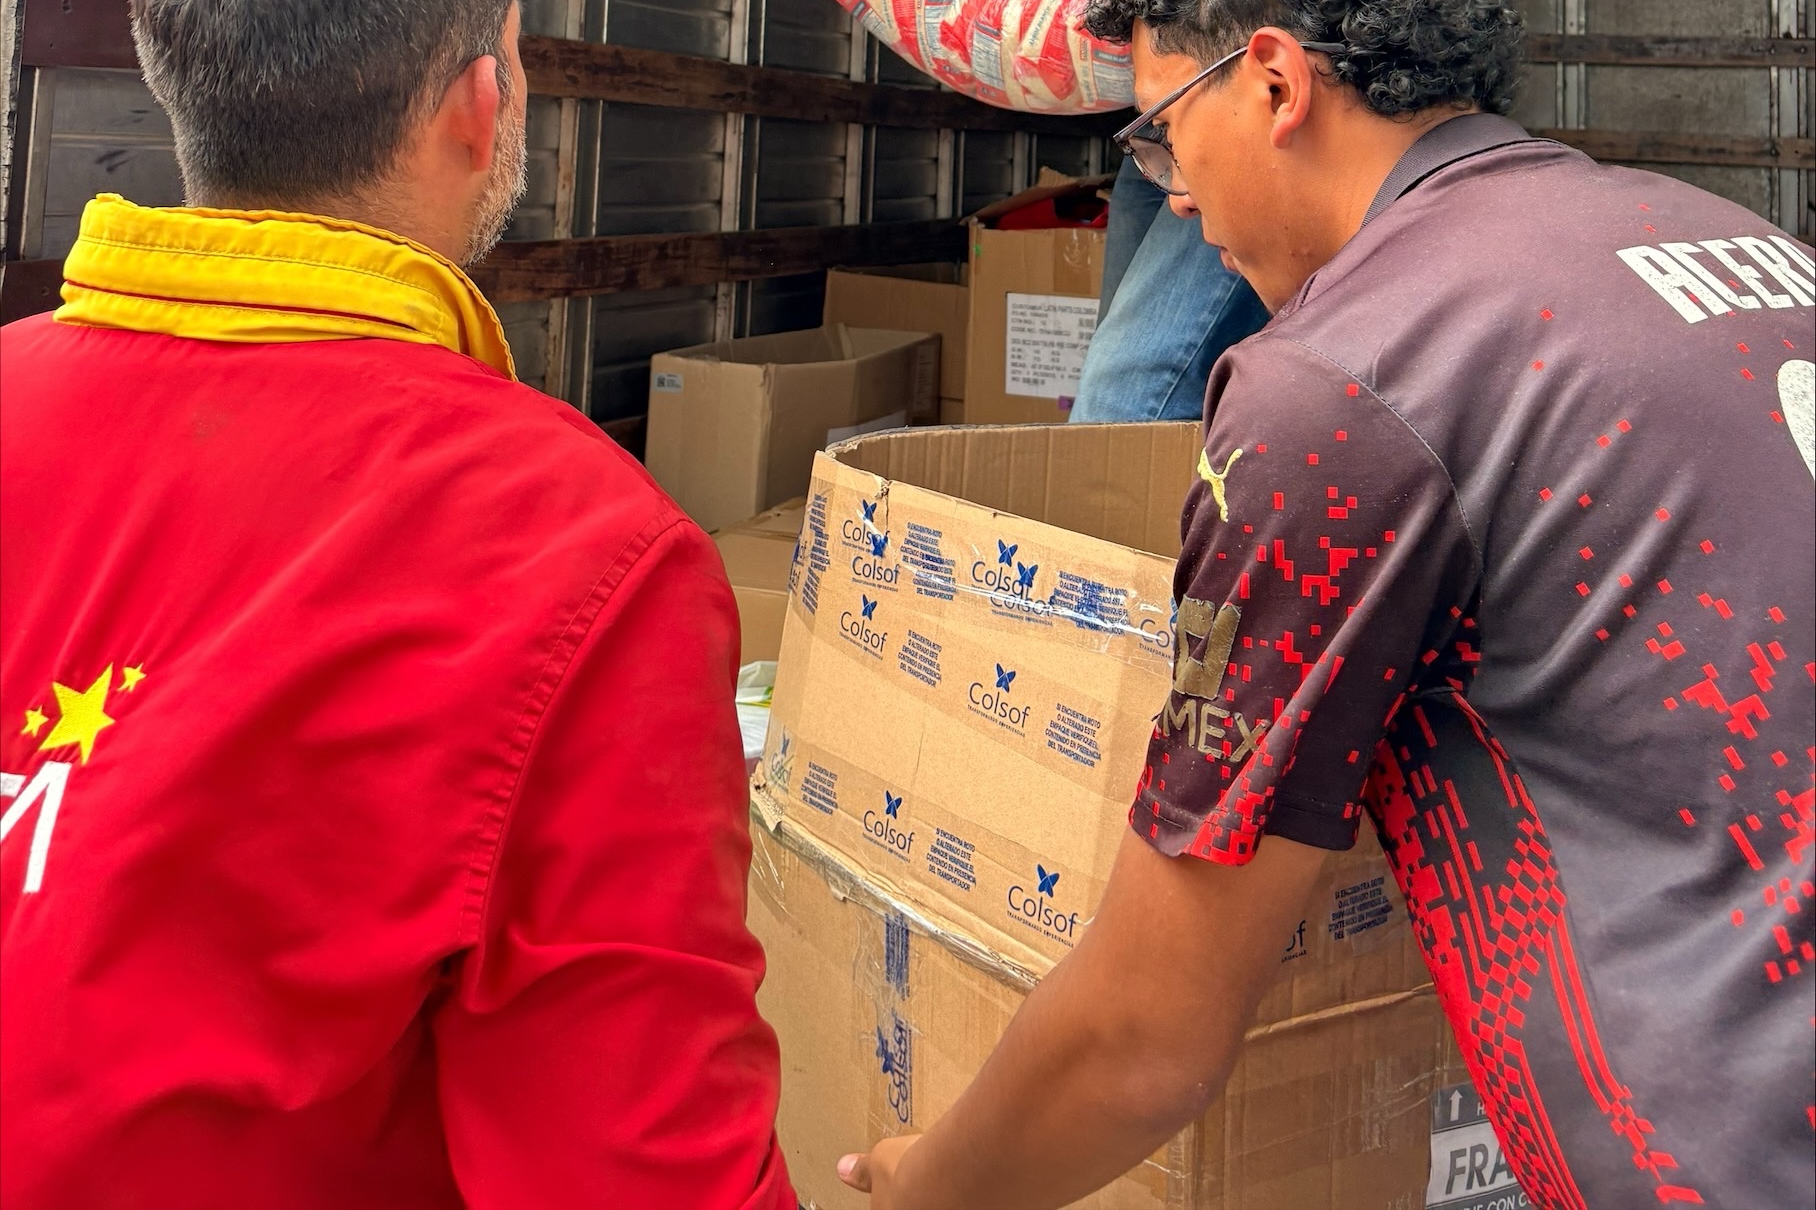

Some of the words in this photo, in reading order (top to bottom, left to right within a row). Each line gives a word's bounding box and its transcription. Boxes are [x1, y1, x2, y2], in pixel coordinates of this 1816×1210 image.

[1614, 234, 1815, 325] ACER
[852, 556, 900, 584] Colsof
[841, 611, 888, 652] Colsof
[969, 682, 1031, 728] Colsof
[863, 810, 915, 854] Colsof
[1008, 885, 1078, 938] Colsof
